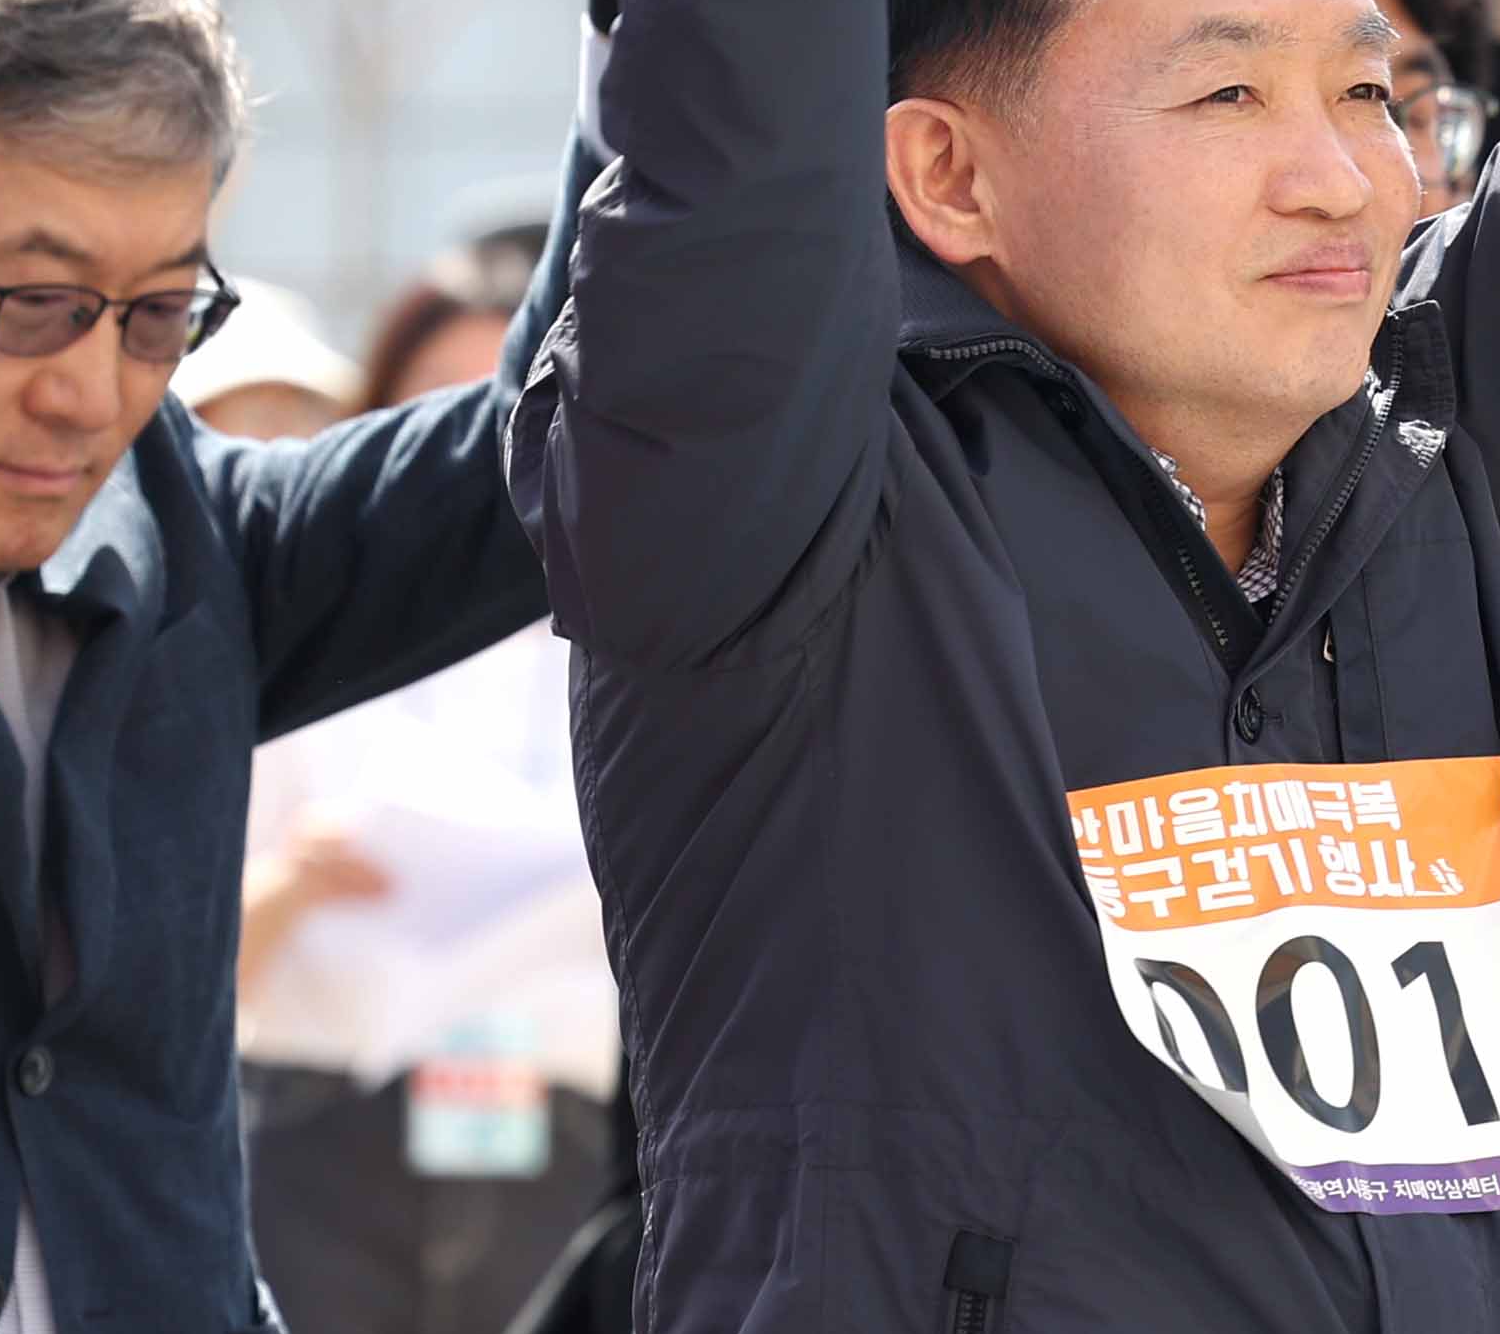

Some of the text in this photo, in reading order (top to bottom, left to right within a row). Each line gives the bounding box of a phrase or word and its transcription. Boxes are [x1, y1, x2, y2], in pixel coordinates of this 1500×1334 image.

[1317, 835, 1417, 898] 행사
[1133, 934, 1500, 1133] 001
[1393, 1174, 1500, 1200] 치매안심센터
